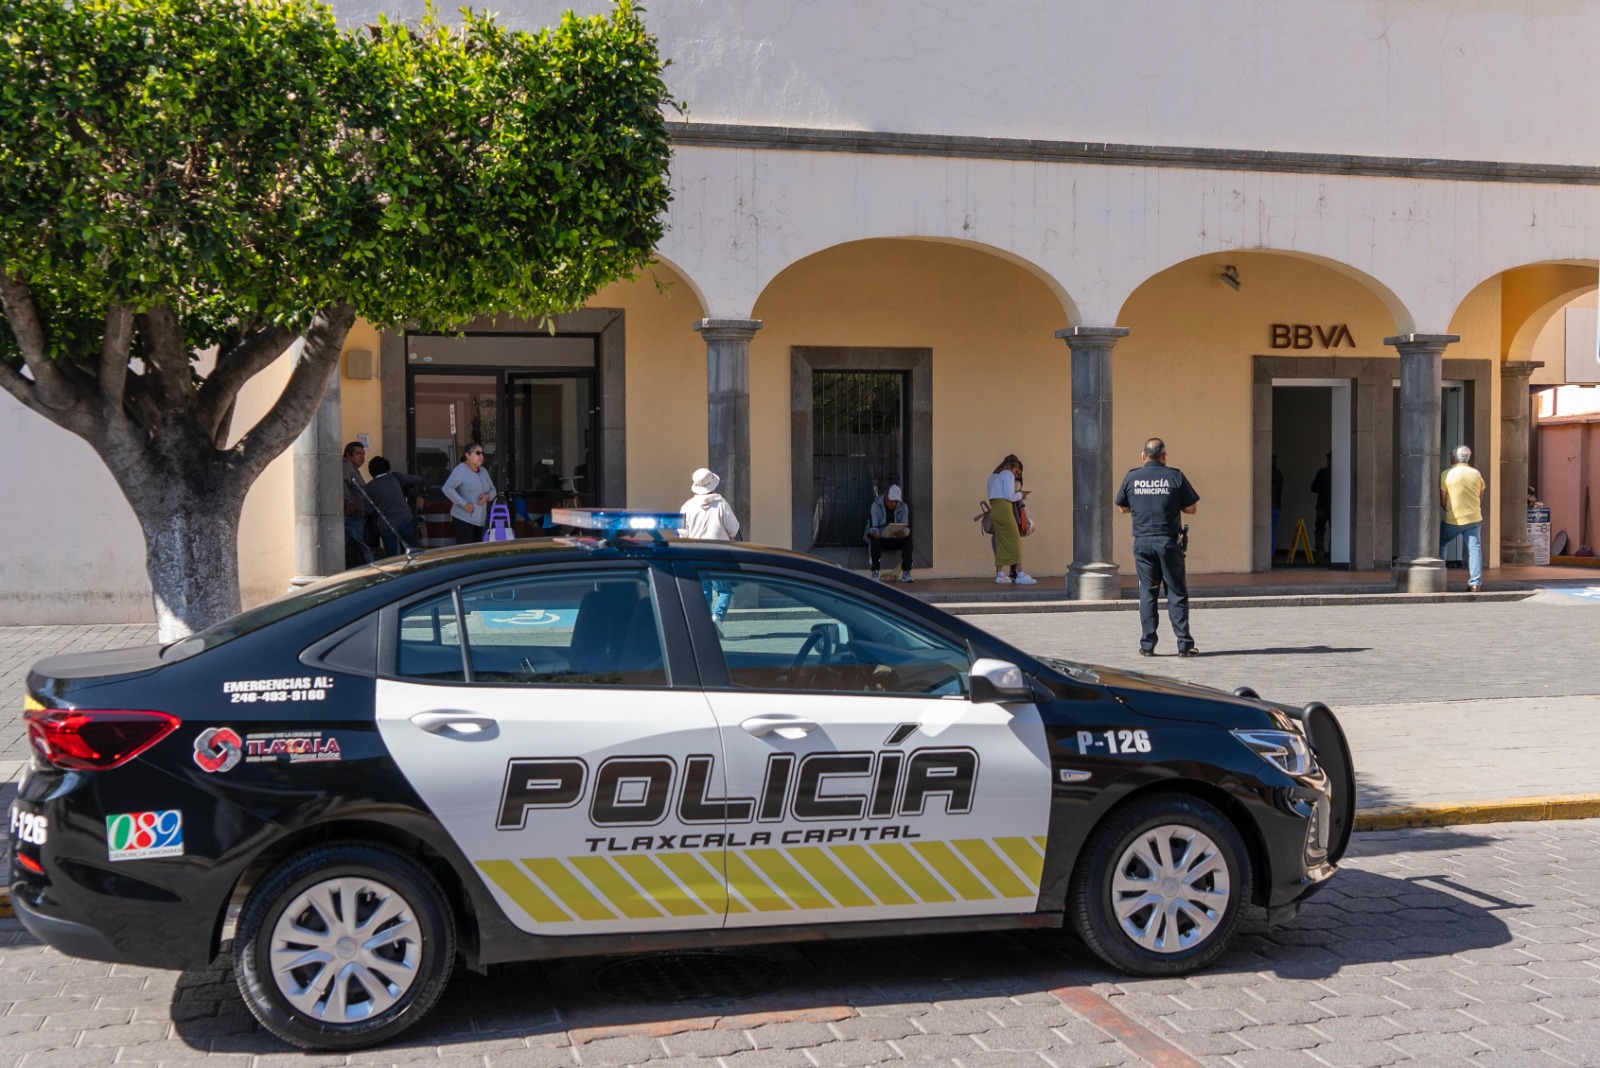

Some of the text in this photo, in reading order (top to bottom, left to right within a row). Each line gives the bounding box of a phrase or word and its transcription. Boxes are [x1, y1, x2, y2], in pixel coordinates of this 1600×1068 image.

[1271, 324, 1356, 349] BBVA
[1134, 478, 1170, 488] POLICÍA
[1134, 487, 1170, 495] MUNICIPAL
[223, 676, 334, 693] EMERGENCIAS AL:
[246, 738, 341, 755] TLAXCALA
[1077, 729, 1152, 755] P-126
[495, 723, 980, 831] POLICÍA
[109, 810, 181, 851] 089
[585, 825, 922, 852] TLAXCALA CAPITAL
[110, 851, 147, 860] DENUNCIA
